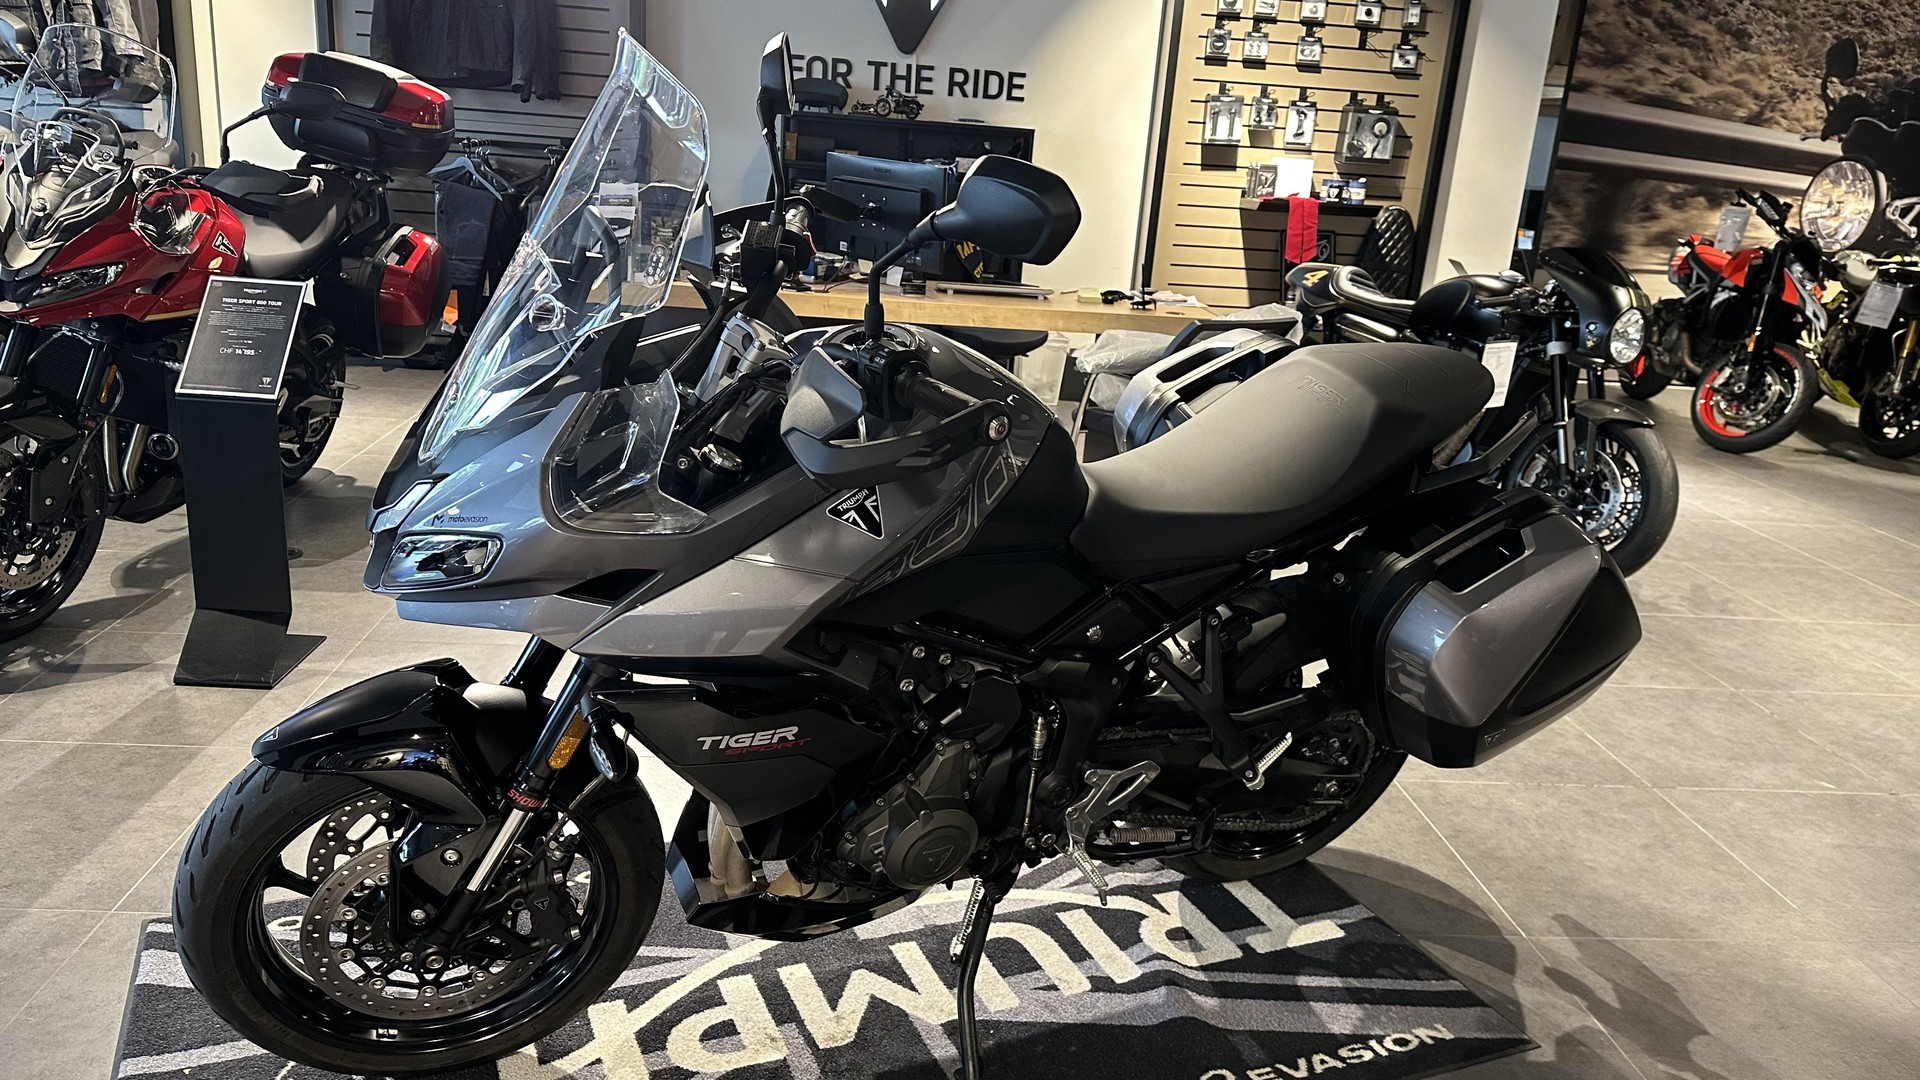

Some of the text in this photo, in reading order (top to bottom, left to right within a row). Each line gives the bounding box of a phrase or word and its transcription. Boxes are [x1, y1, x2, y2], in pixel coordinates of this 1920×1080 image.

[790, 54, 1027, 102] FOR THE RIDE
[1302, 270, 1329, 287] 4
[837, 488, 869, 512] TRIUMPH
[447, 514, 489, 523] motoevasion
[696, 725, 799, 751] TIGER
[723, 737, 812, 756] SPORT
